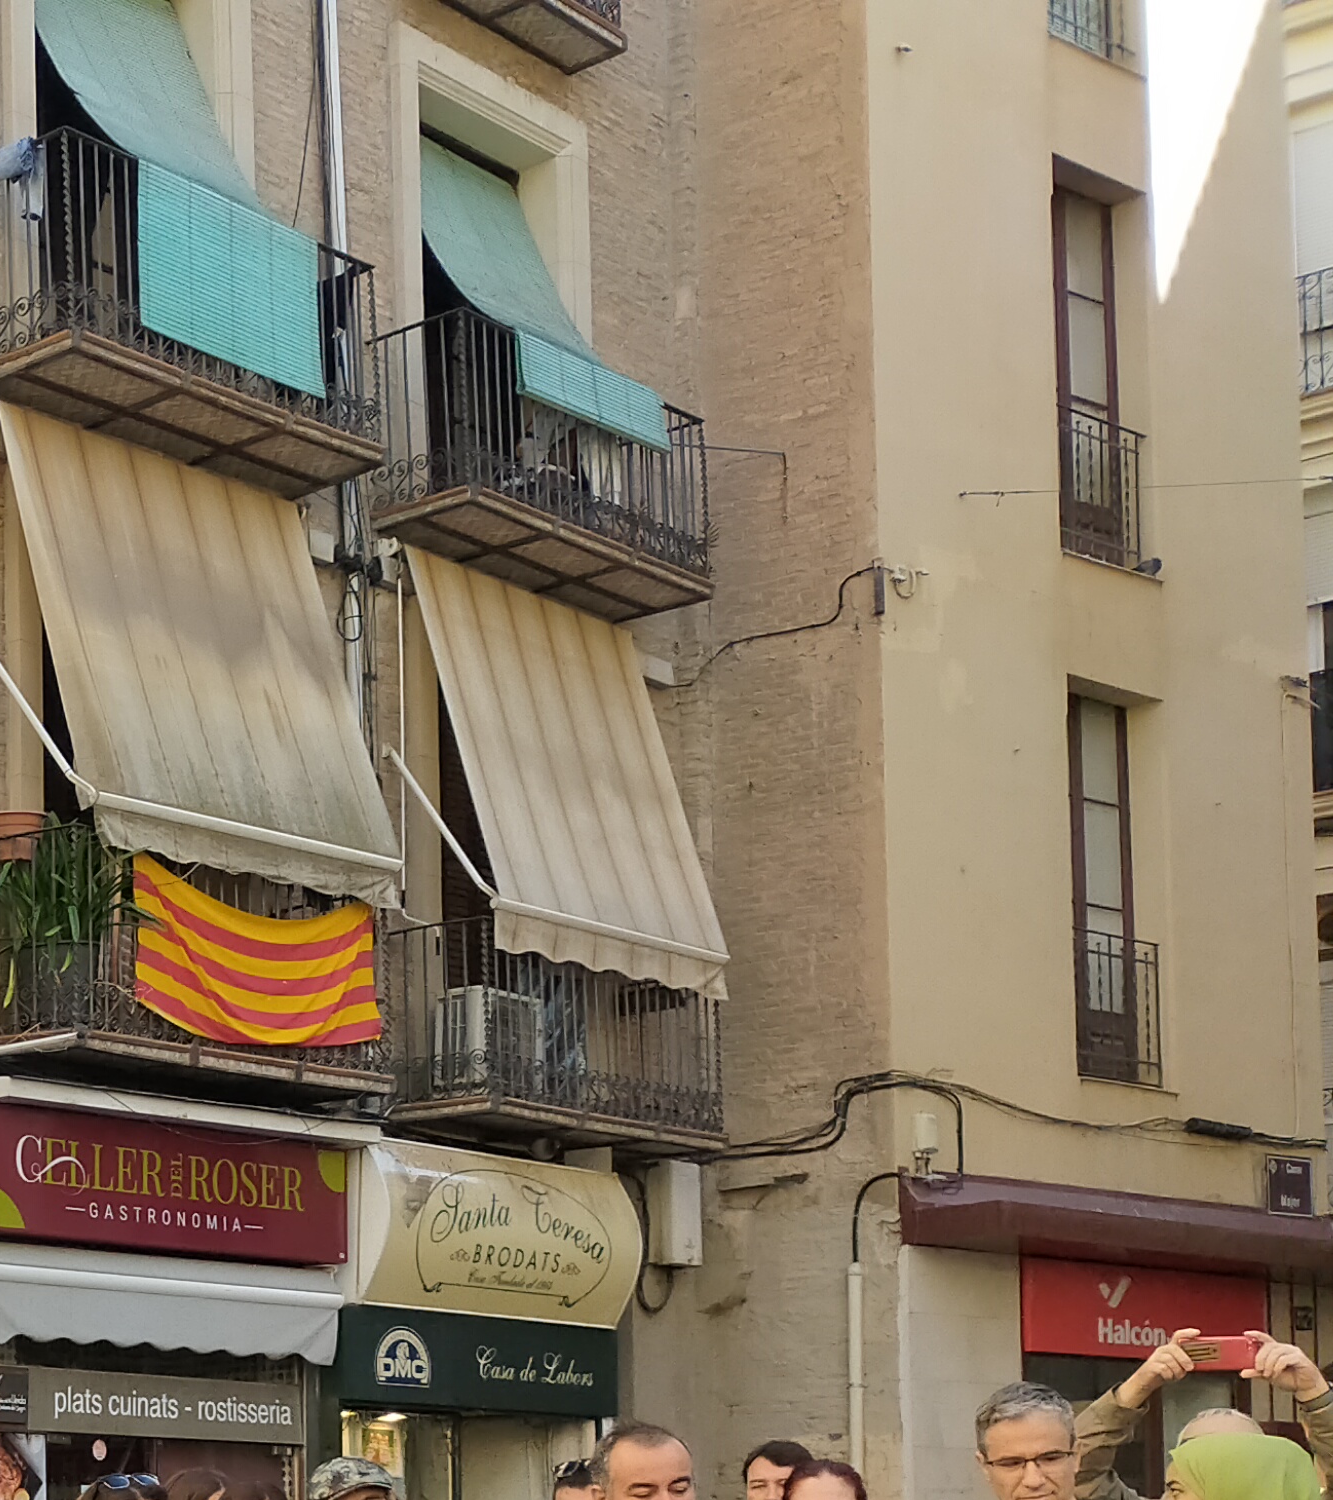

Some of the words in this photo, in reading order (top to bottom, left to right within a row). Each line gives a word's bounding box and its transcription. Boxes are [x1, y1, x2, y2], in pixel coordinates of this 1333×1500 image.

[15, 1134, 165, 1198] CELLER
[170, 1152, 183, 1198] DEL
[187, 1154, 306, 1212] ROSER
[88, 1201, 242, 1233] GASTRONOMIA
[430, 1181, 512, 1243] Santa
[521, 1184, 605, 1265] Teresa
[472, 1243, 562, 1274] BRODATS
[1098, 1317, 1166, 1347] Halcón
[377, 1357, 427, 1379] DMC
[476, 1345, 515, 1379] Casa
[519, 1355, 537, 1383] de
[540, 1352, 594, 1387] Labors
[54, 1385, 103, 1419] plats
[107, 1389, 179, 1420] cuinats
[197, 1396, 293, 1426] rostisseria
